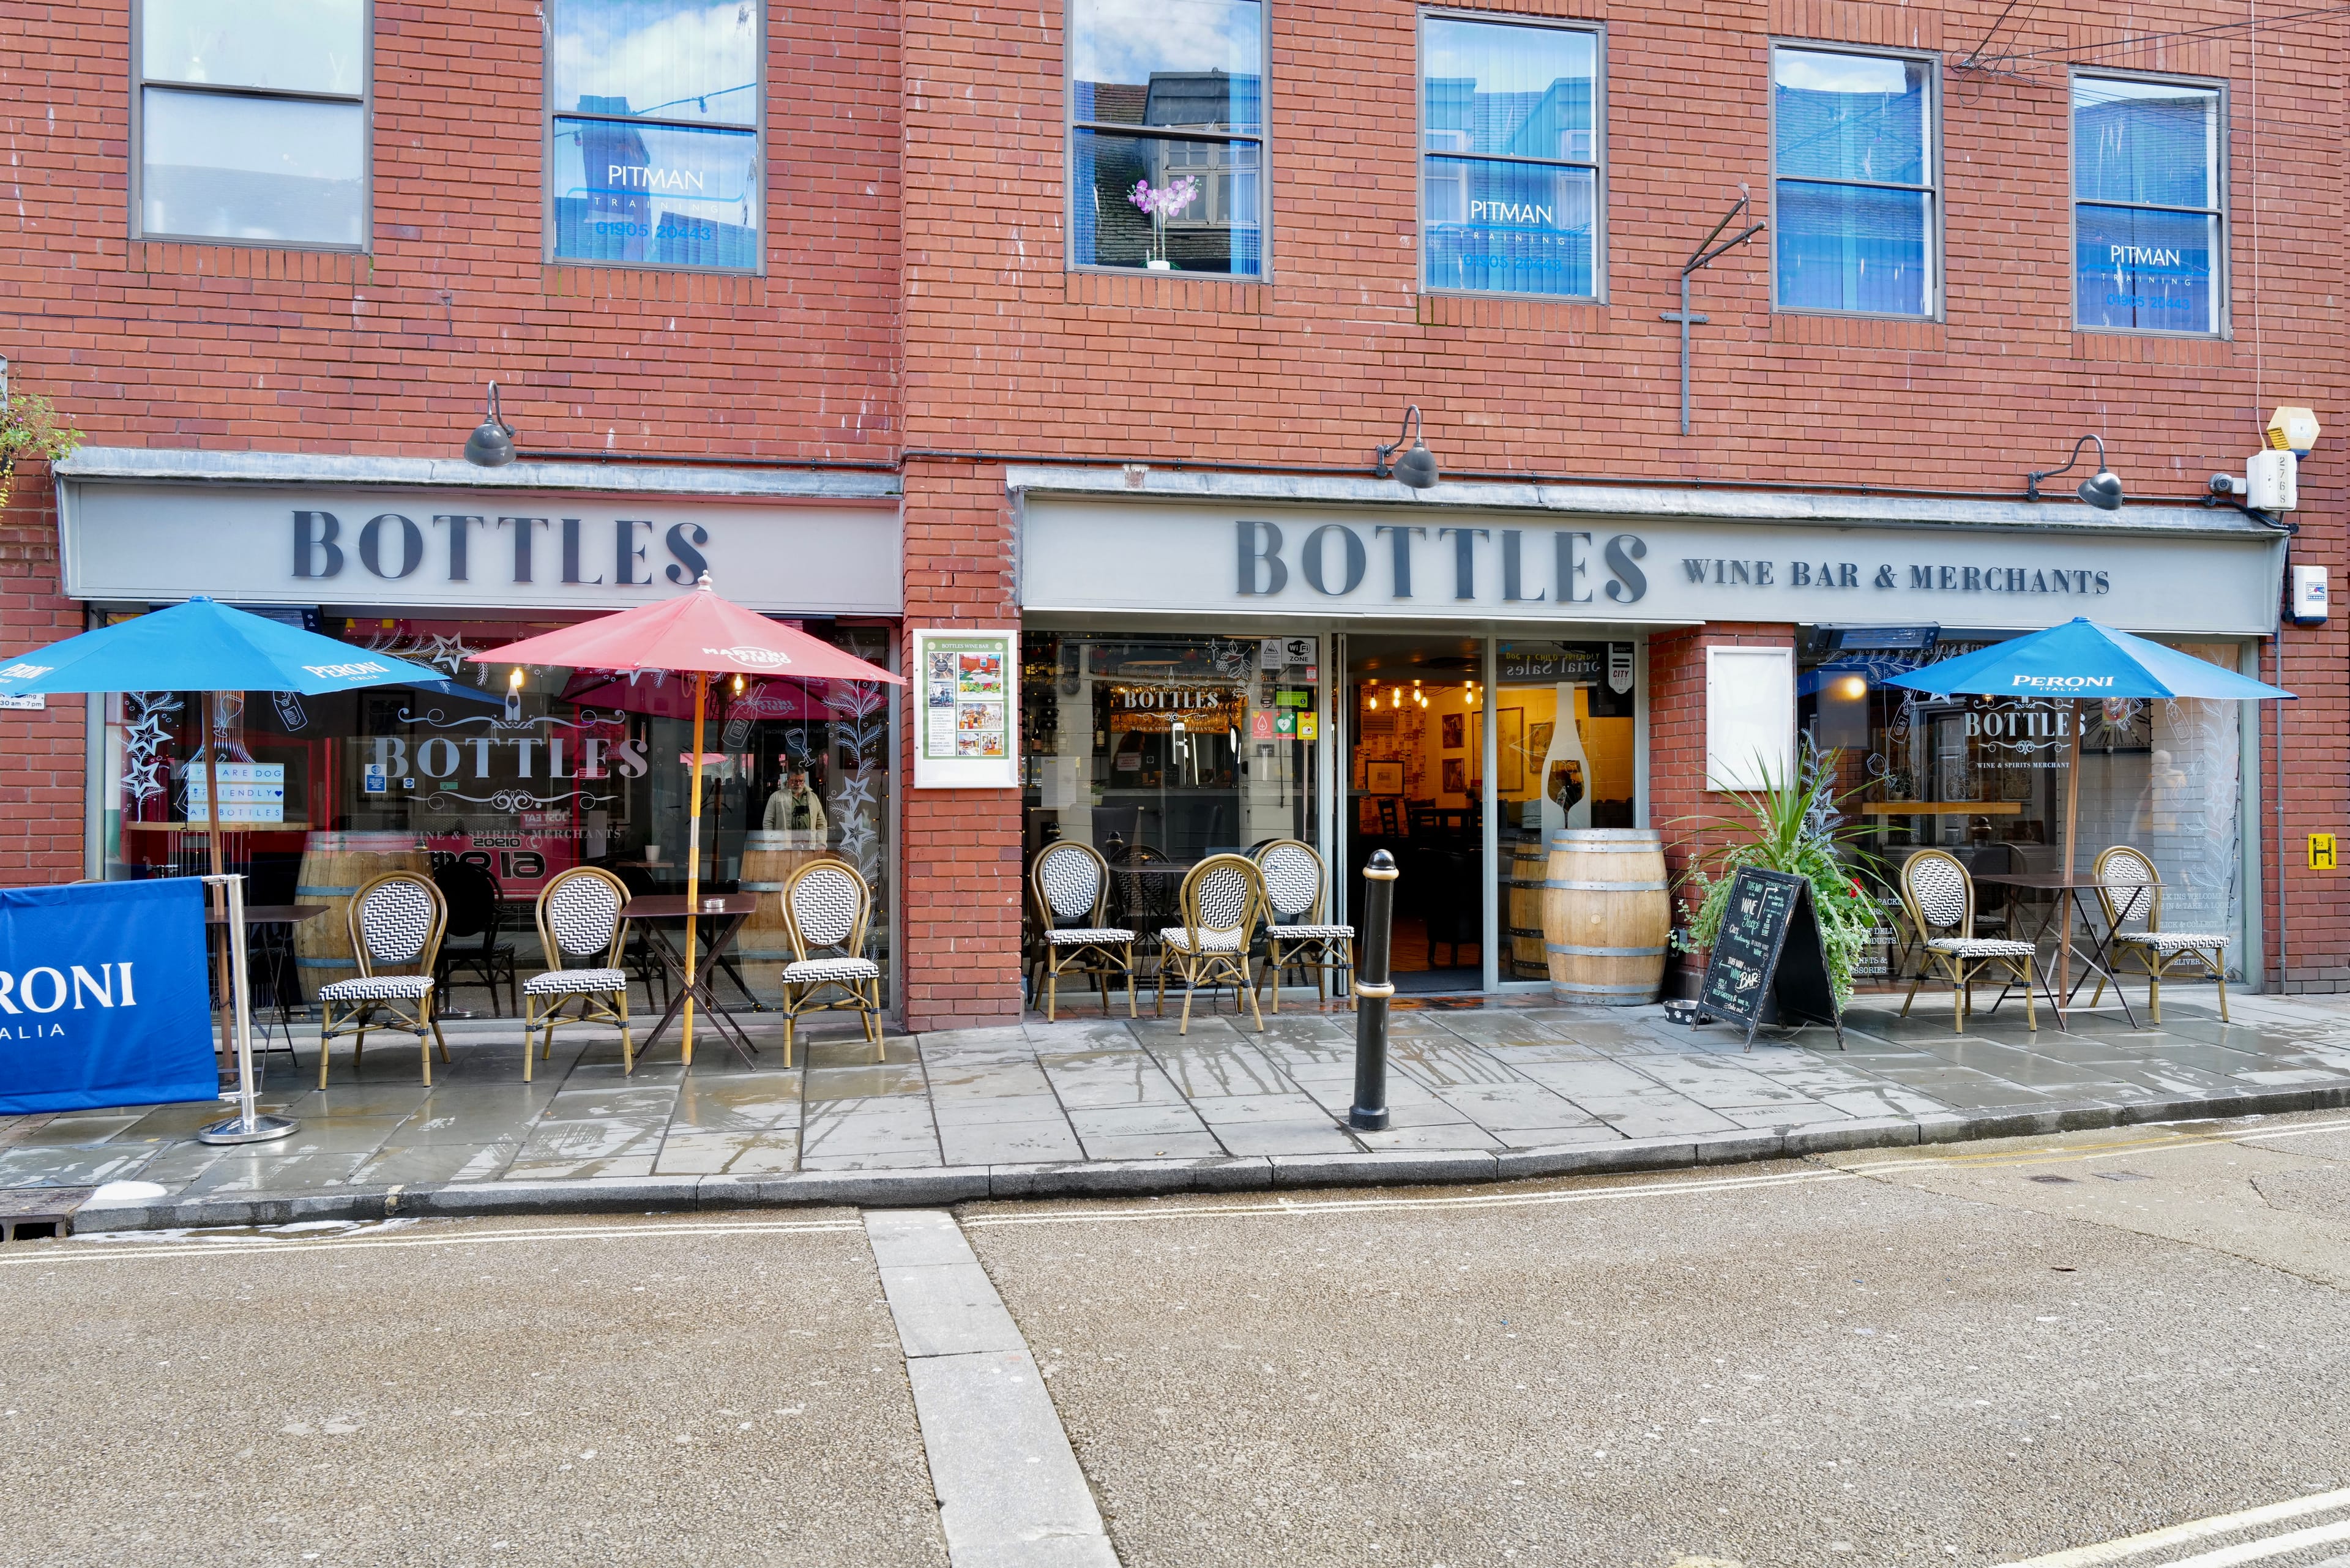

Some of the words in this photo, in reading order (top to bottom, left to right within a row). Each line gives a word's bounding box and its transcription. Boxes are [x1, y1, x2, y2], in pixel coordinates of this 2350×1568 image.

[608, 165, 703, 191] PITMAN
[594, 197, 718, 213] TRAINING
[1471, 200, 1552, 224] PITMAN
[595, 221, 649, 237] 01905
[657, 226, 711, 241] 20443
[1459, 231, 1565, 245] TRAINING
[1463, 253, 1509, 269] 01905
[1515, 256, 1562, 272] 20443
[2111, 245, 2179, 267] PITMAN
[2101, 273, 2191, 286] TRAINING
[291, 510, 709, 586] BOTTLES
[1235, 521, 1647, 603] BOTTLES
[1682, 558, 1774, 585] WINE
[1790, 561, 1859, 588] BAR
[1874, 564, 1897, 589] &
[1909, 564, 2110, 595] MERCHANTS
[702, 648, 788, 659] MARTINI
[739, 655, 792, 664] FIERO
[1506, 652, 1520, 660] DOG
[301, 661, 391, 679] PERONI
[2012, 675, 2114, 687] PERONI
[1124, 691, 1218, 708] BOTTLES
[374, 736, 649, 779] BOTTLES
[405, 831, 444, 840] WINE
[451, 831, 461, 840] &
[468, 829, 526, 840] SPIRITS
[532, 829, 621, 839] MERCHANTS
[2313, 837, 2332, 865] H
[1741, 897, 1758, 915] WINE
[0, 962, 137, 1014] RONI
[1736, 971, 1758, 990] BAR
[0, 1023, 65, 1040] ALIA
